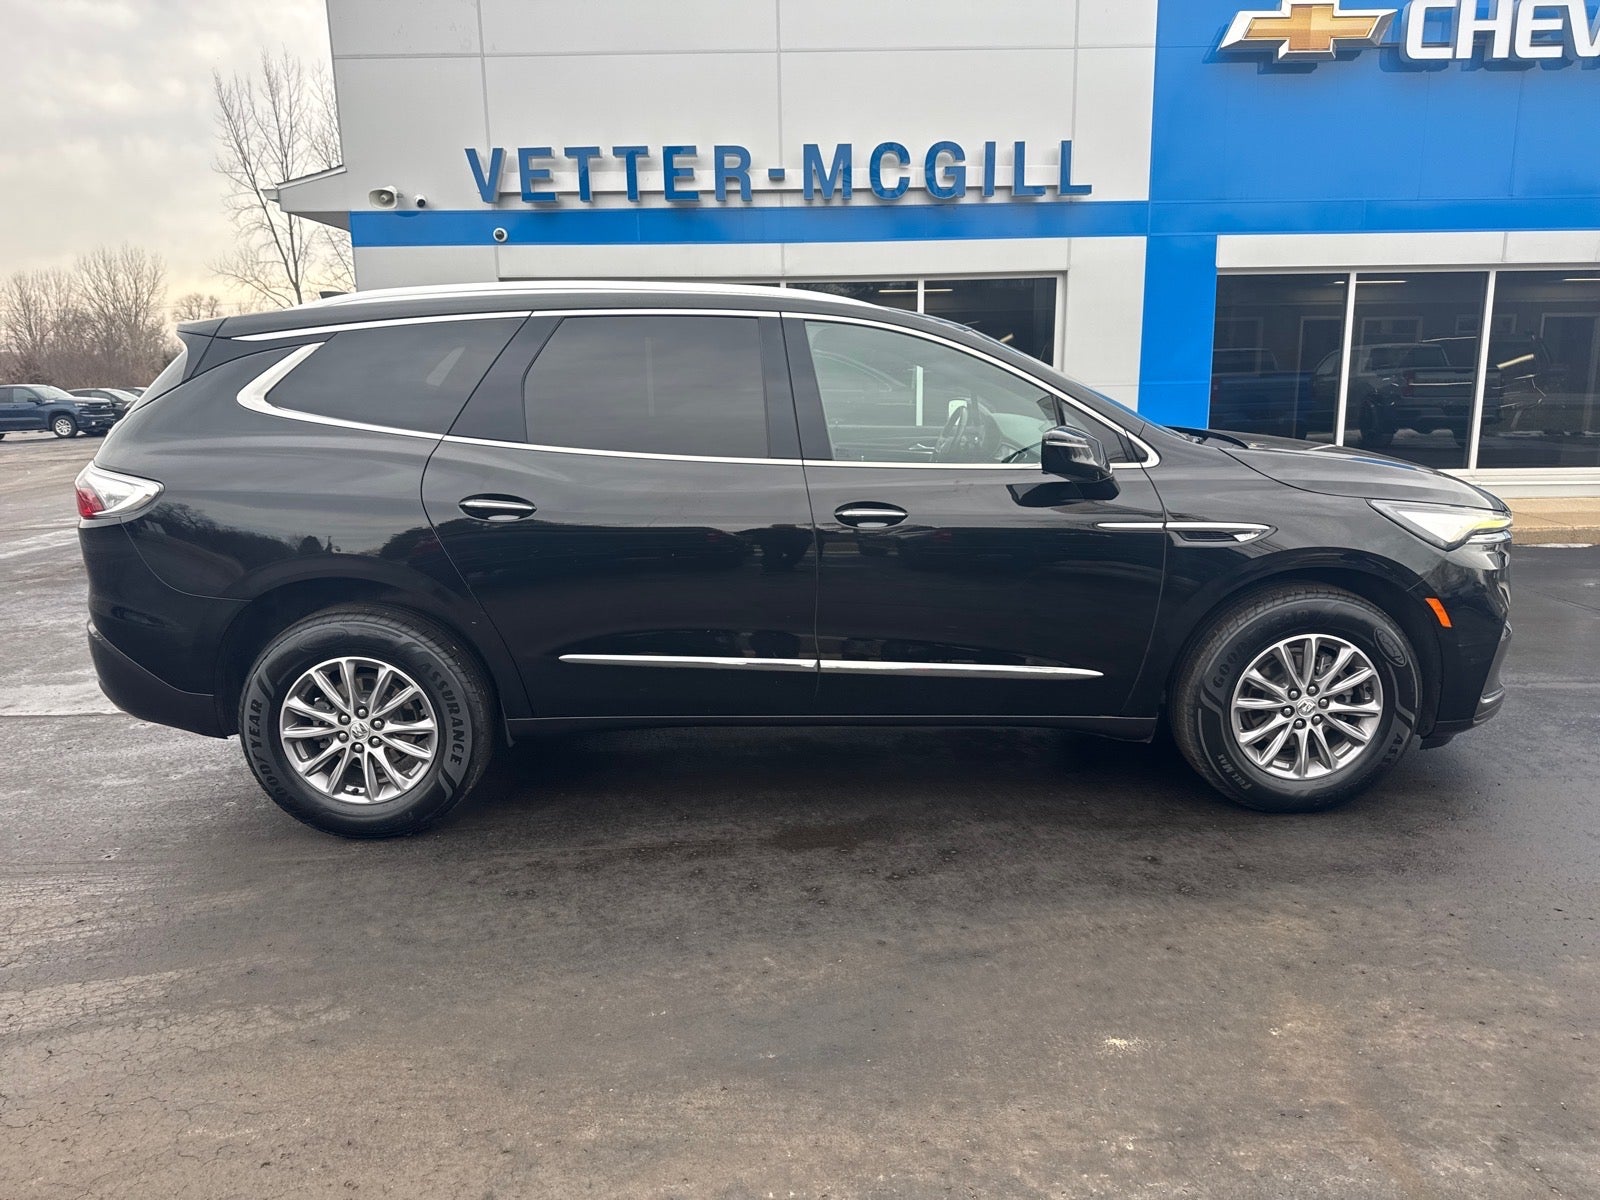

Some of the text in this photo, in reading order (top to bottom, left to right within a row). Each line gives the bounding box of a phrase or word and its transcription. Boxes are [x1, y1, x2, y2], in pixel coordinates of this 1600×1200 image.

[1406, 0, 1600, 59] CHEV
[465, 140, 1093, 203] VETTER-MCGILL
[421, 662, 466, 766] ASSURANCE
